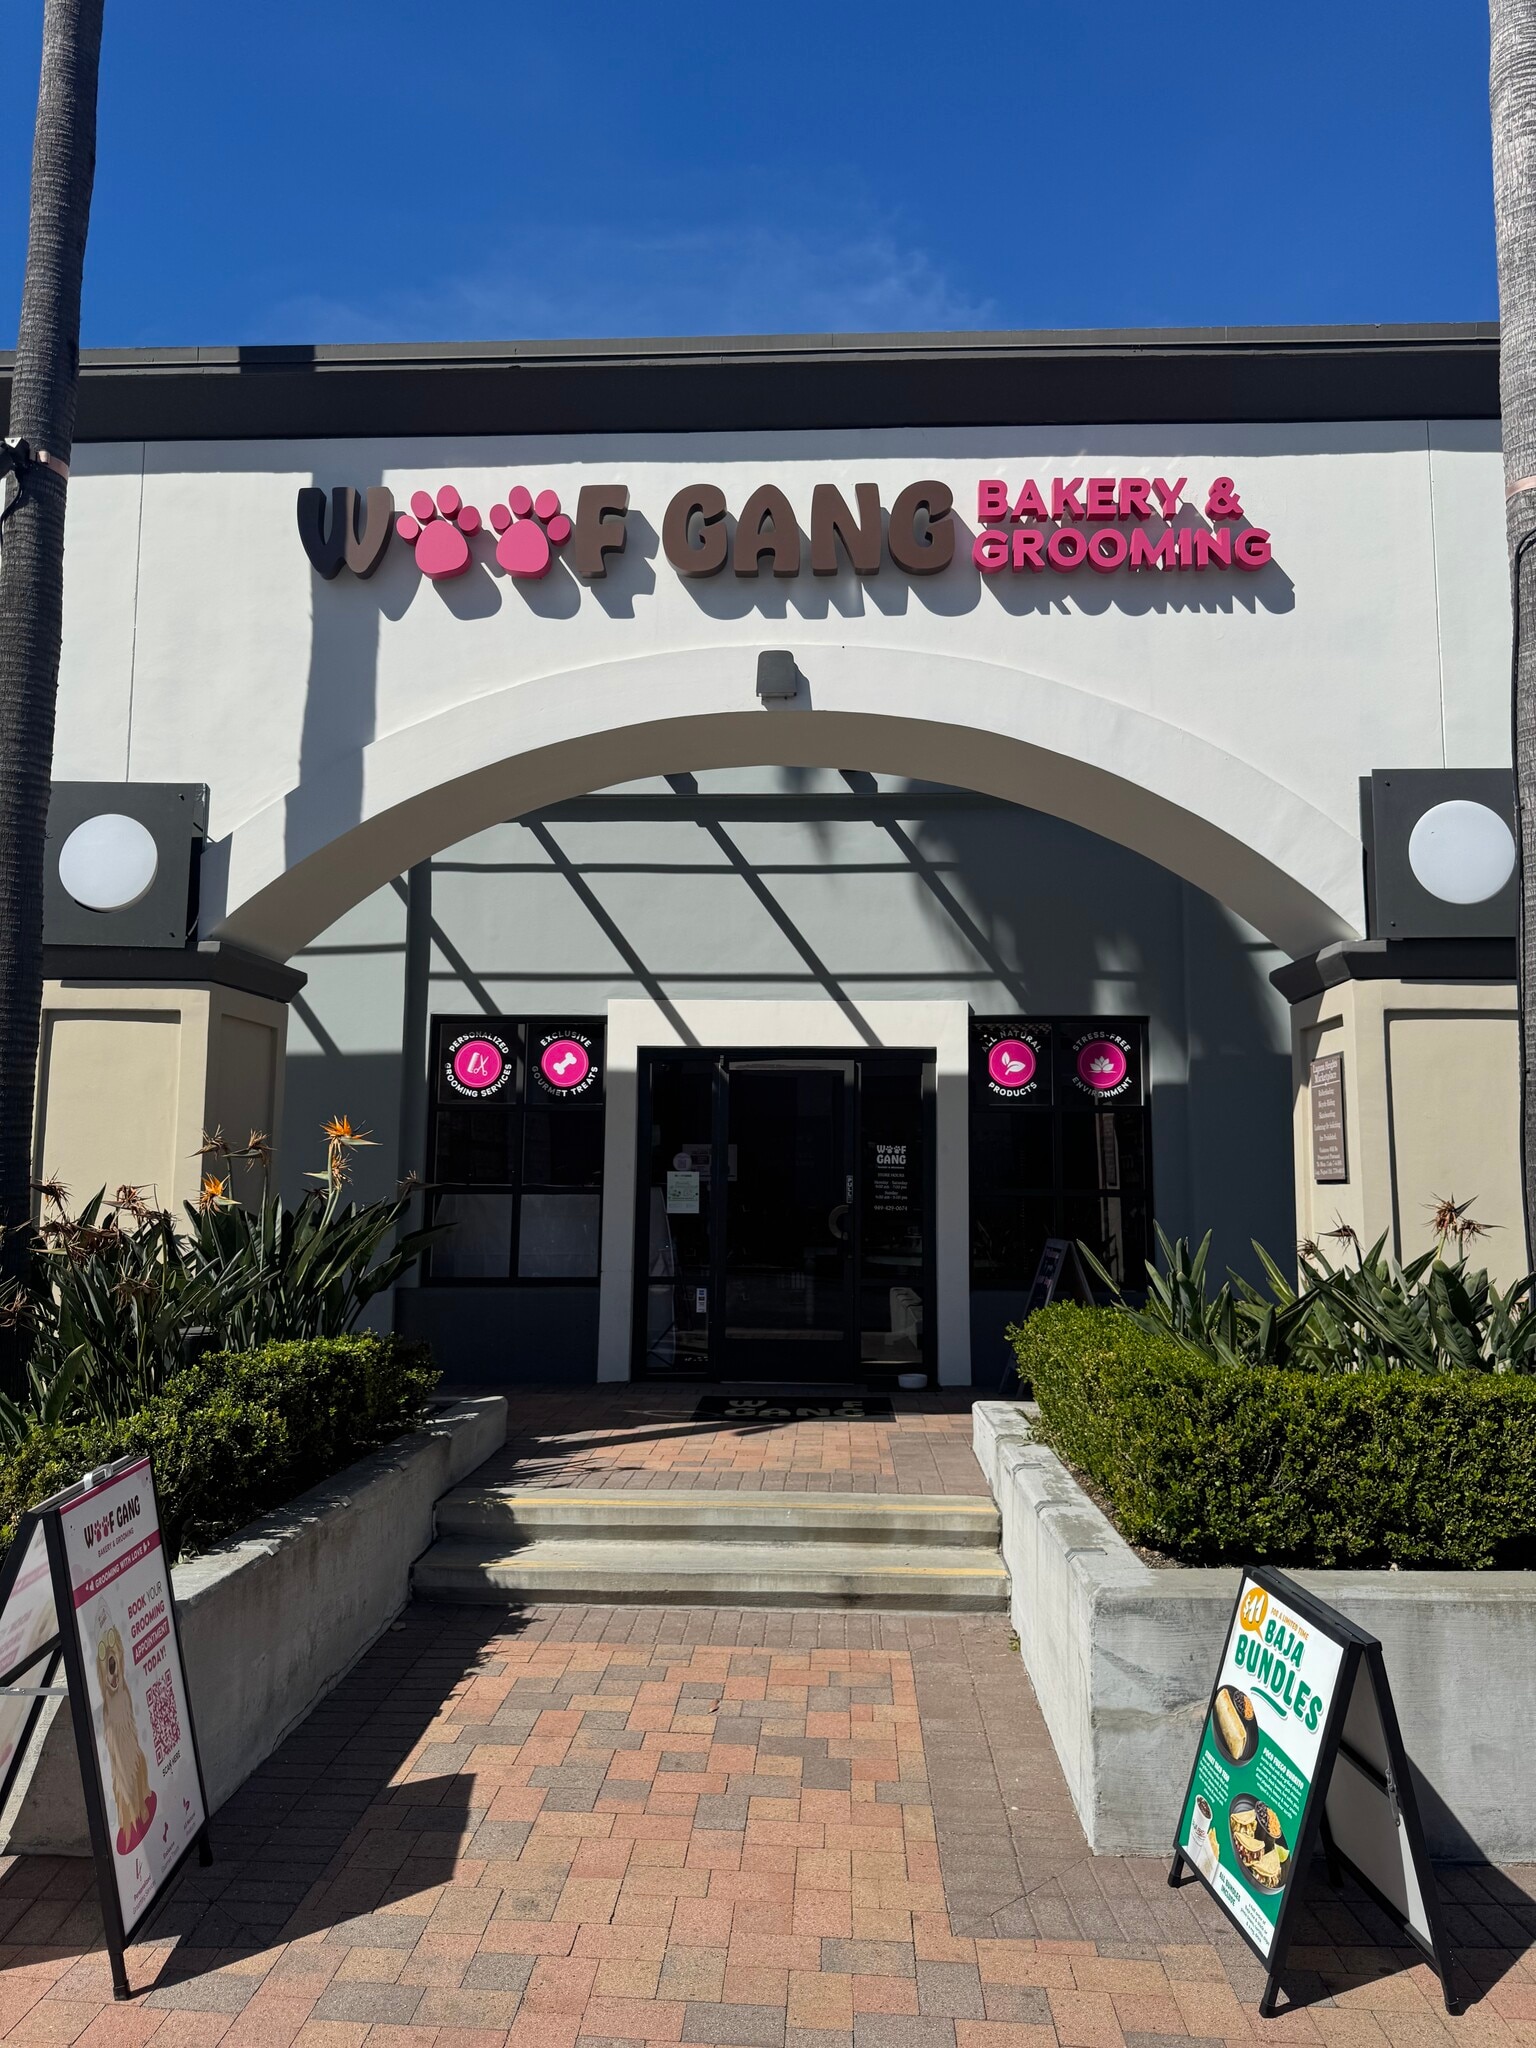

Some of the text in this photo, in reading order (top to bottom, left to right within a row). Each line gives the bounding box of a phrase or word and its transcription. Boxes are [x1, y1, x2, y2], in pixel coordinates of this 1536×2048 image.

[977, 477, 1244, 523] BAKERY &
[662, 480, 956, 578] GANG
[972, 527, 1272, 573] GROOMING
[449, 1031, 510, 1054] PERSONALIZED
[540, 1030, 592, 1048] EXCLUSIVE
[981, 1030, 1042, 1053] ALL NATURAL
[1072, 1031, 1131, 1052] STRESS-FREE
[444, 1062, 512, 1098] GROOMING SERVICES
[531, 1066, 599, 1097] GOURMET TREATS
[988, 1081, 1038, 1097] PRODUCTS
[1071, 1076, 1133, 1098] ENVIRONMENT
[876, 1154, 907, 1165] GANG
[116, 1495, 141, 1528] GANG
[95, 1564, 120, 1588] GROOMING
[131, 1547, 143, 1561] LOVE
[128, 1594, 147, 1619] BOOK
[146, 1581, 162, 1602] YOUR
[131, 1600, 165, 1638] GROOMING
[1271, 1607, 1279, 1617] FOR
[1282, 1614, 1299, 1631] LIMITED
[1298, 1626, 1310, 1640] TIME
[134, 1620, 168, 1661] APPOINTMENT
[1265, 1619, 1305, 1668] BAJA
[143, 1645, 167, 1676] TODAY!
[1235, 1634, 1322, 1731] BUNDLES
